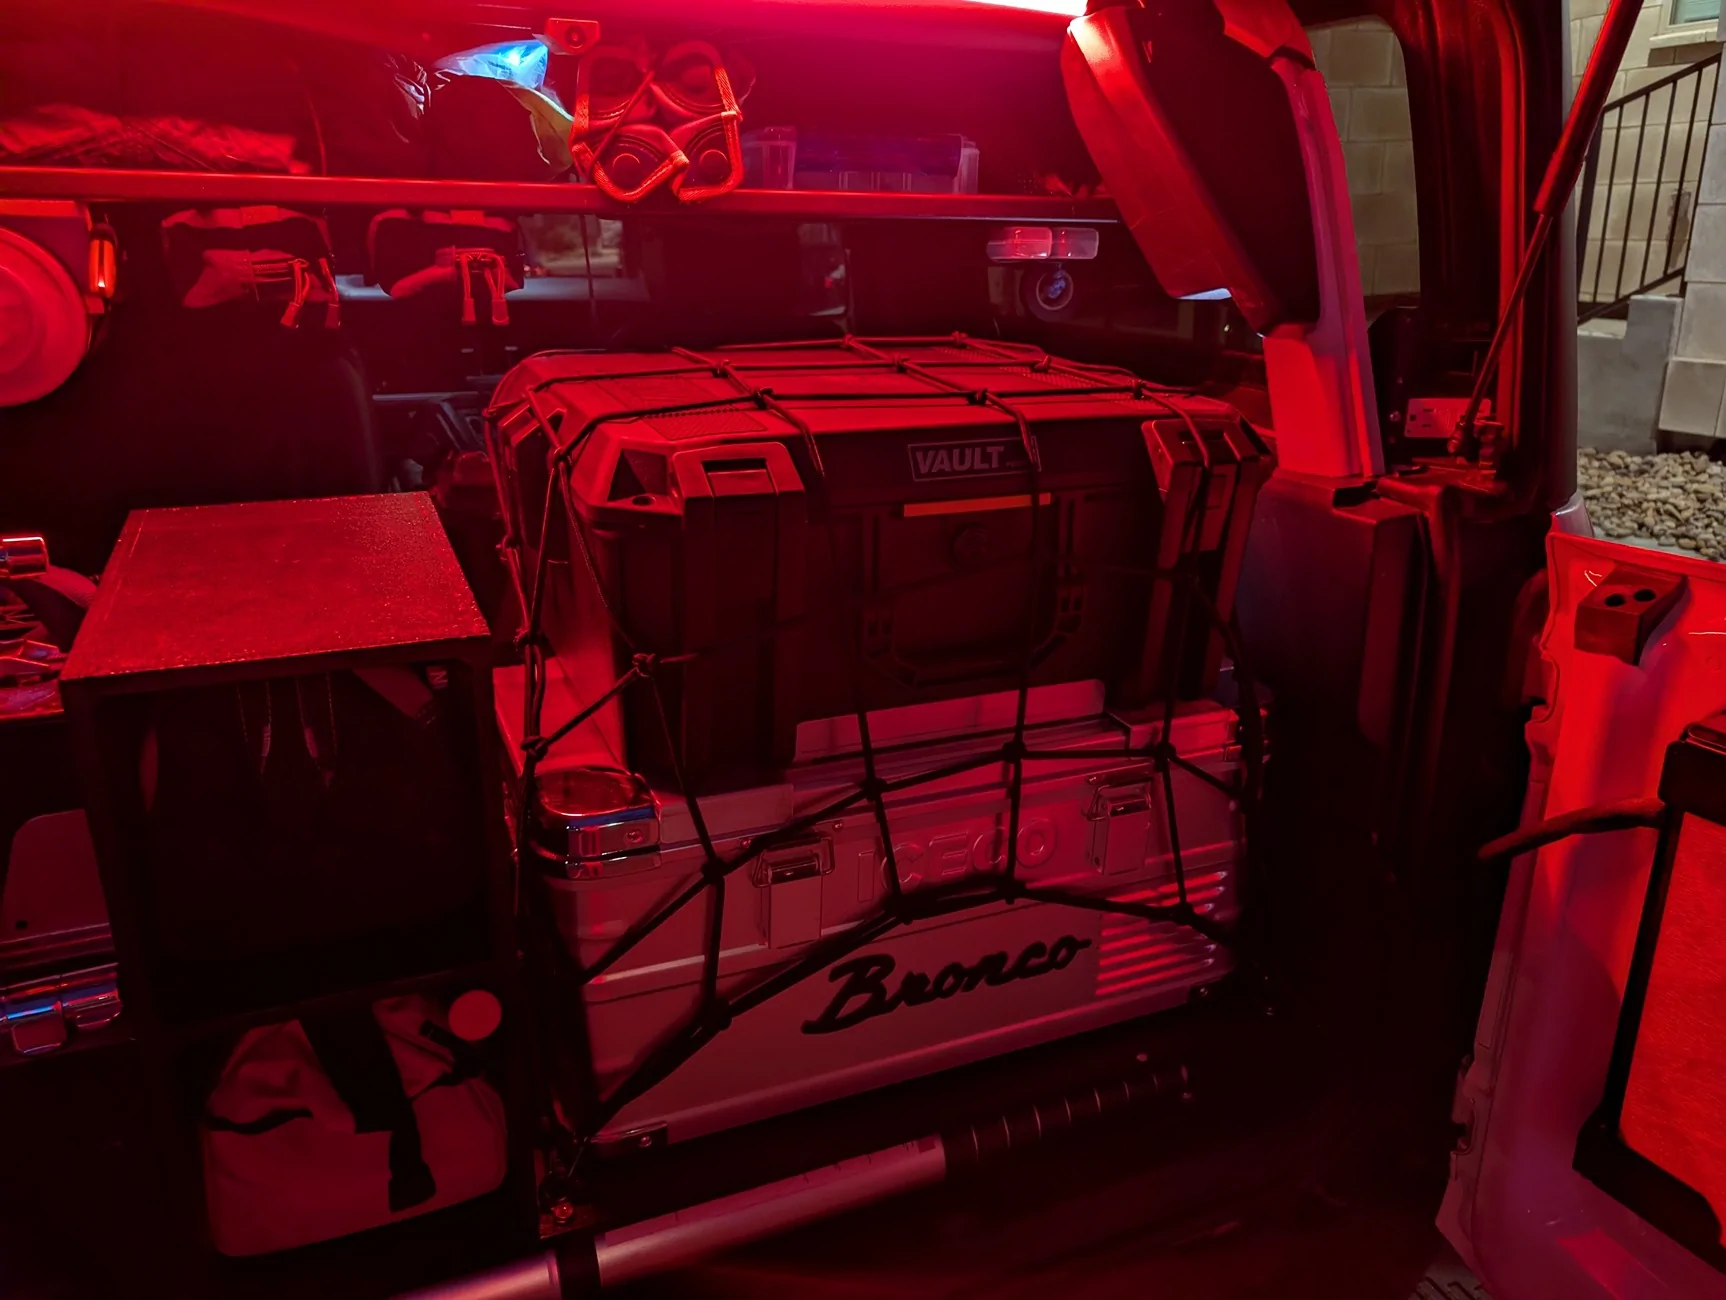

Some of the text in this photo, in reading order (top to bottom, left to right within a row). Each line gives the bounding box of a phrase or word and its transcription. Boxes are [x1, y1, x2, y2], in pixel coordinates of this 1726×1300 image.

[916, 446, 1004, 474] VAULT
[857, 817, 1058, 903] ICECO
[801, 935, 1092, 1034] Bronco
